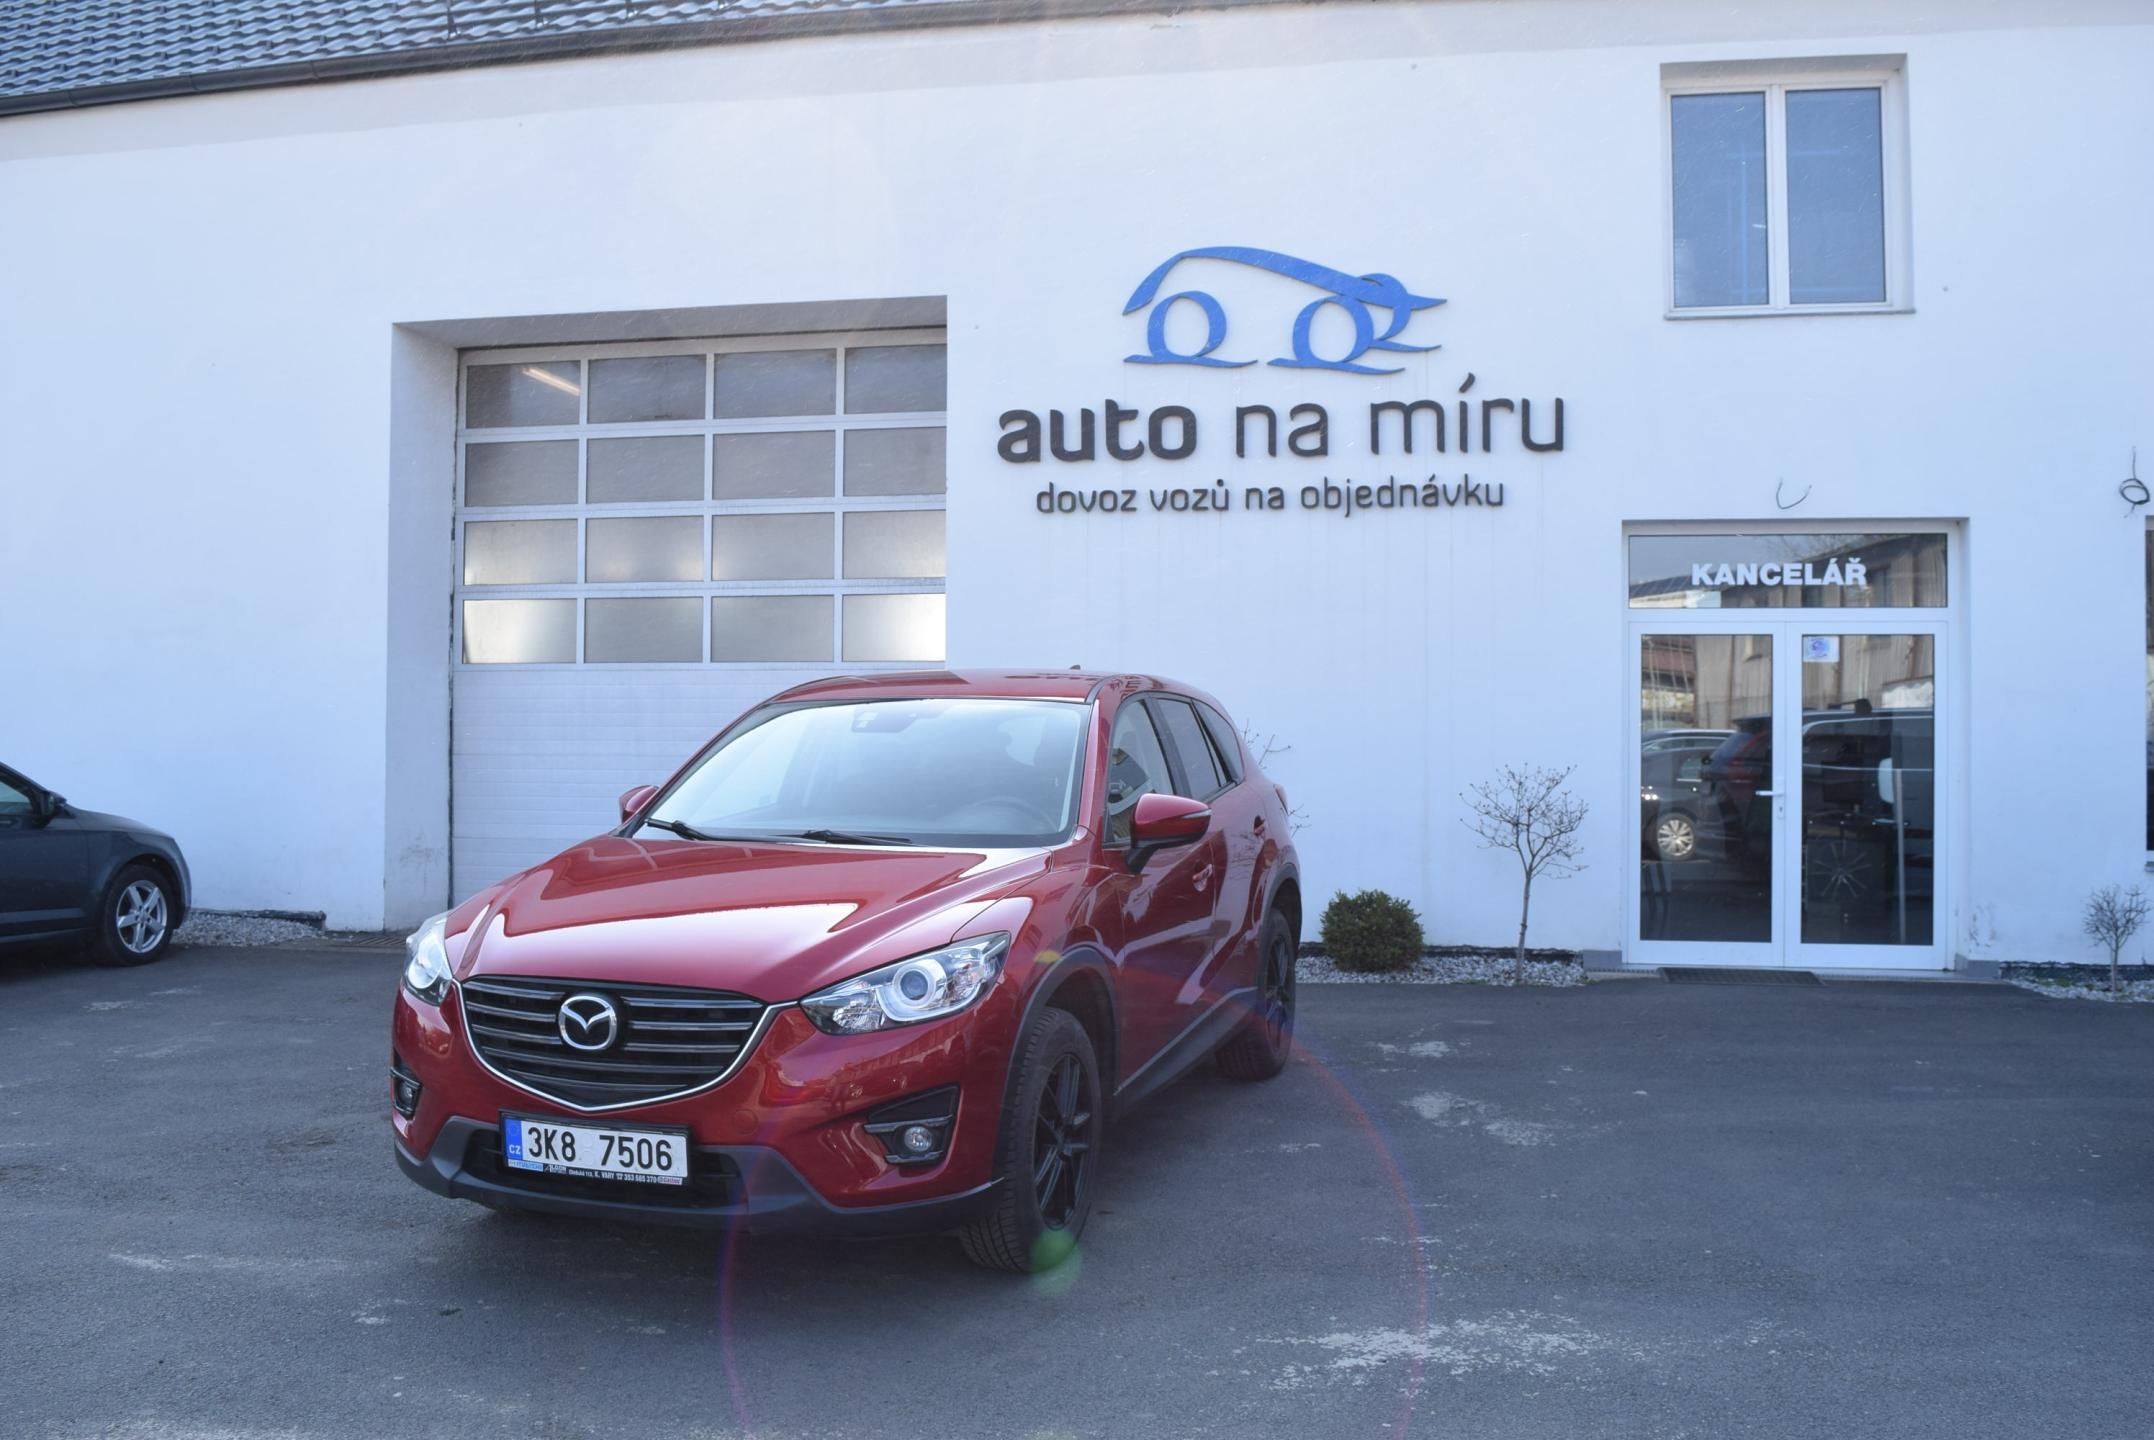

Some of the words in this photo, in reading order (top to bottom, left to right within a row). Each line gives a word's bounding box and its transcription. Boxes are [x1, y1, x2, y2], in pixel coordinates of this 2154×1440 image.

[997, 399, 1197, 464] auto
[1235, 403, 1329, 459] na
[1370, 372, 1564, 455] míru
[1036, 481, 1137, 514] dovoz
[1149, 478, 1230, 513] vozů
[1245, 486, 1285, 511] na
[1300, 473, 1504, 518] objednávku
[1691, 557, 1868, 587] KANCELÁŘ
[508, 1144, 521, 1155] CZ
[527, 1126, 576, 1162] 3K8
[599, 1134, 673, 1171] 7506
